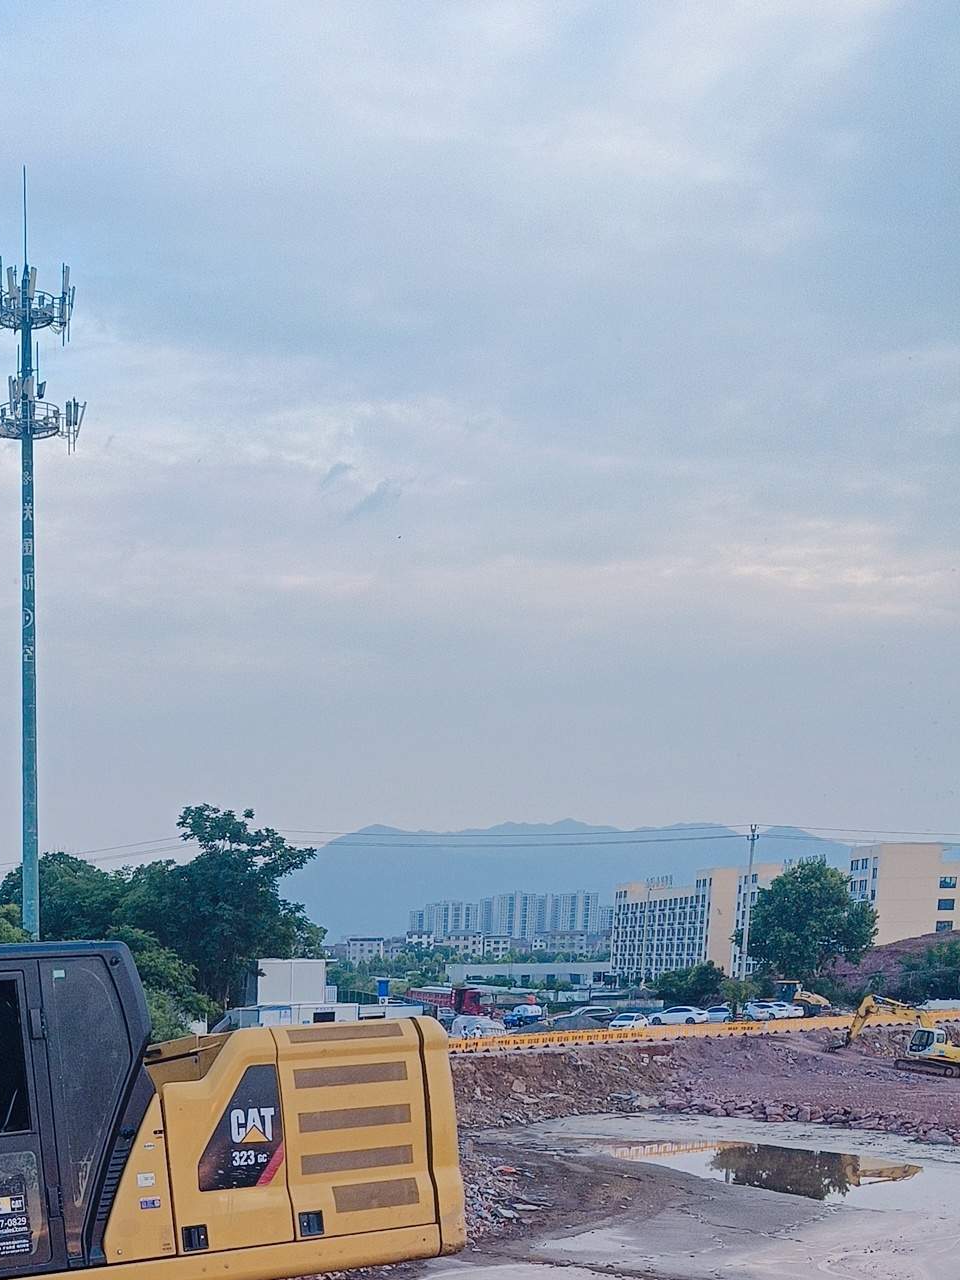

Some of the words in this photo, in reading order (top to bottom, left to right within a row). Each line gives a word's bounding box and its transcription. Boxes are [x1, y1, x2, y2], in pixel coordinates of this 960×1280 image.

[231, 1107, 274, 1143] CAT
[232, 1150, 255, 1167] 323
[257, 1153, 268, 1163] GC
